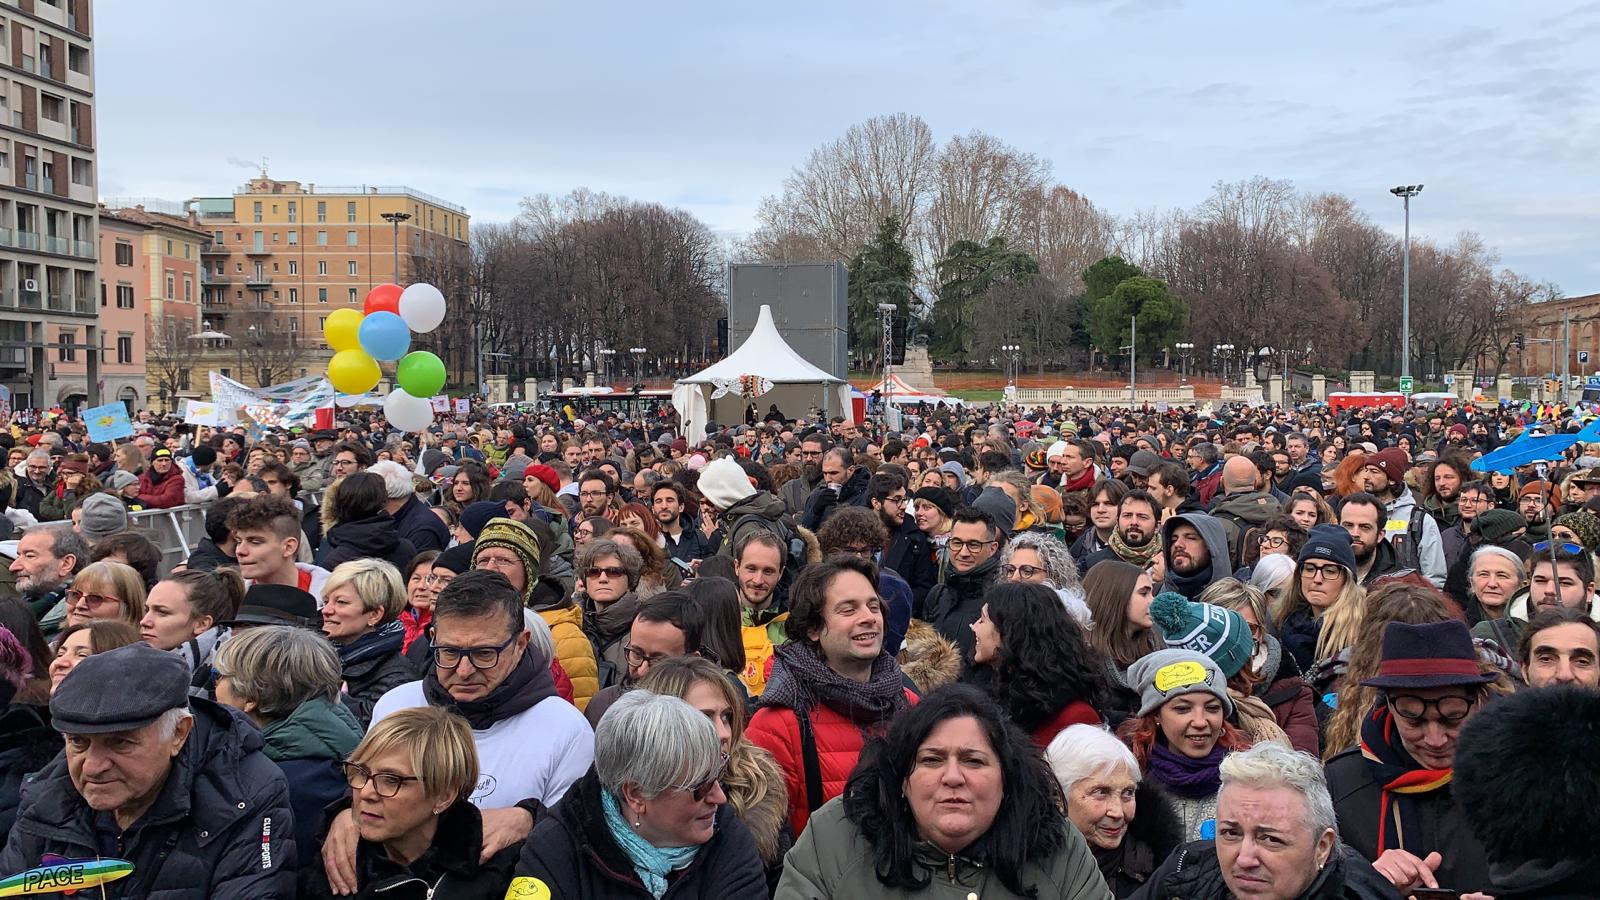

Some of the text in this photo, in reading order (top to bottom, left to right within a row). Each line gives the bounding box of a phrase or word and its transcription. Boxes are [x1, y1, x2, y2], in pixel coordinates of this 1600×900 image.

[263, 817, 271, 836] CLUB
[261, 842, 272, 869] SPORTS
[24, 865, 84, 892] PACE
